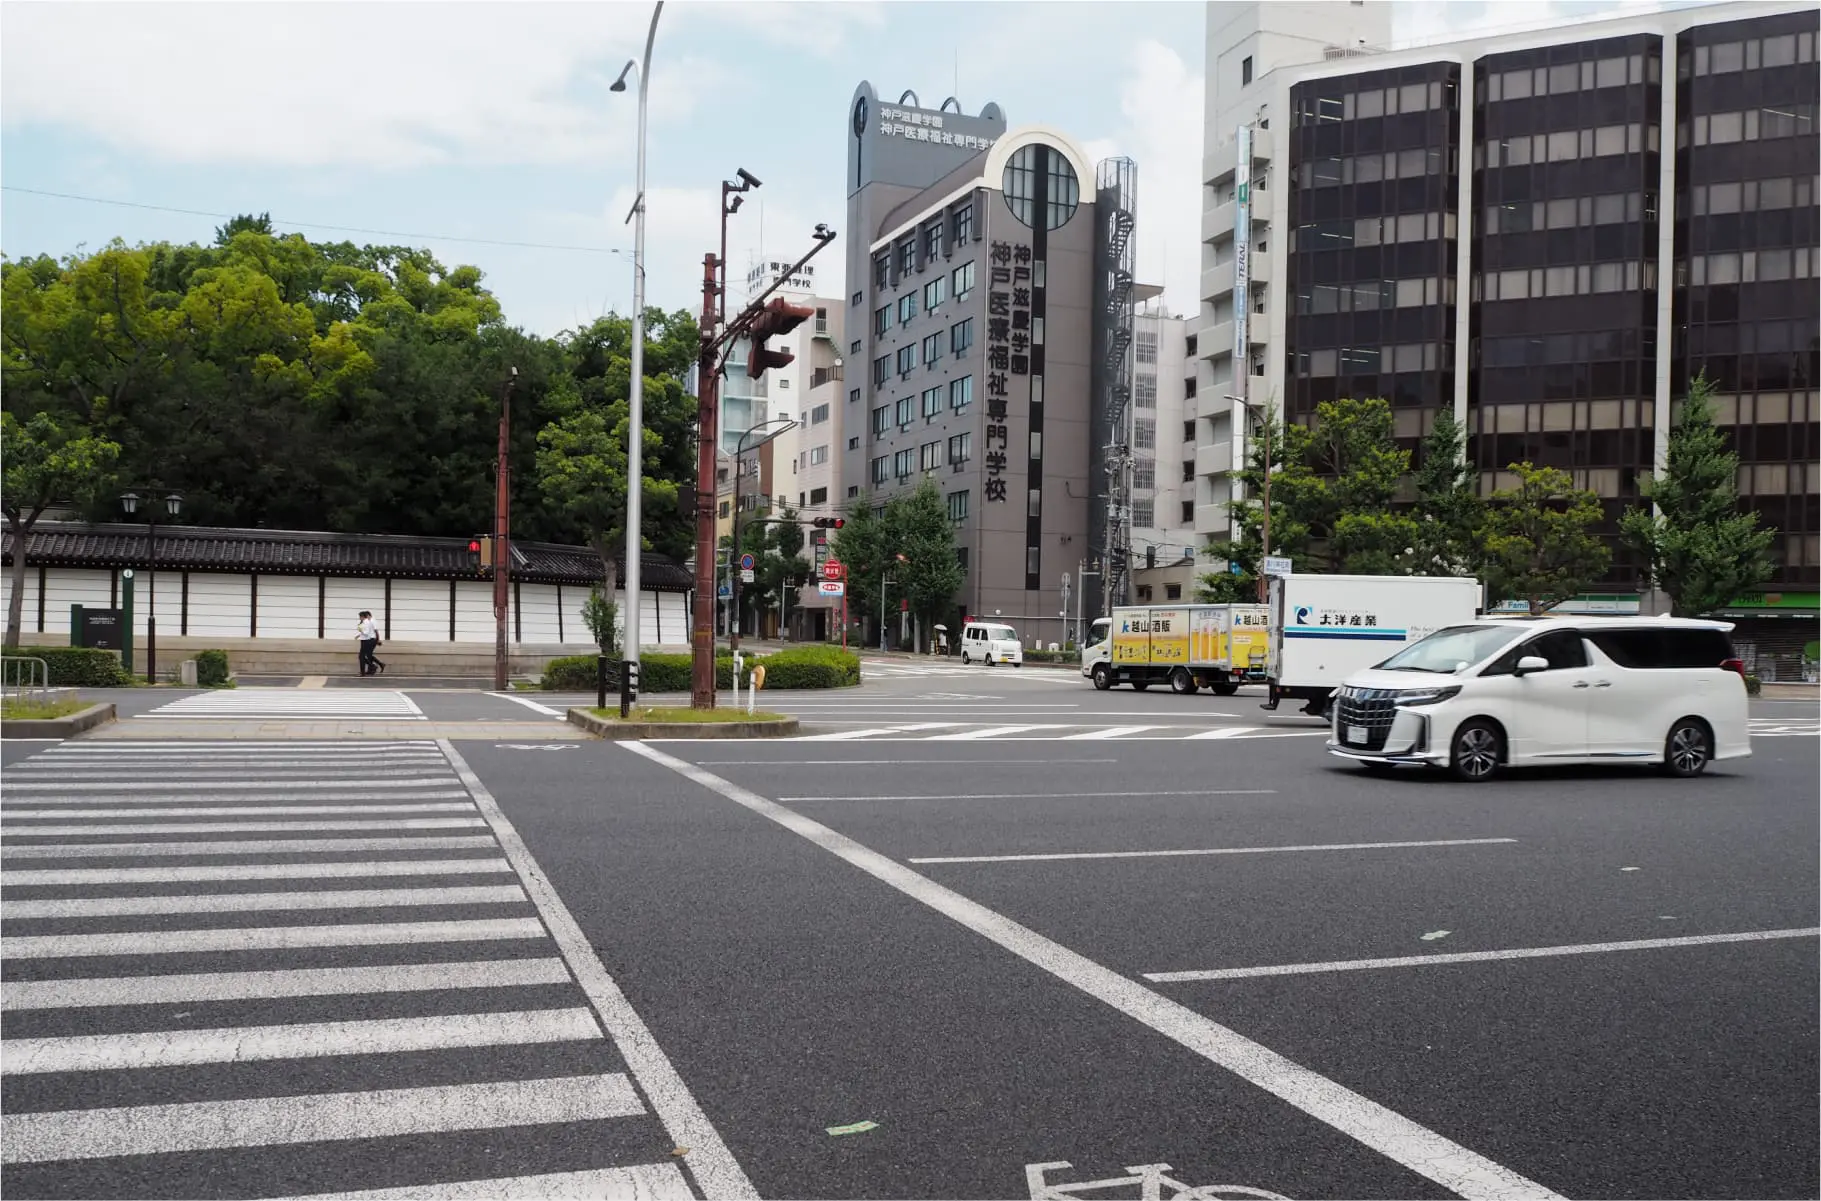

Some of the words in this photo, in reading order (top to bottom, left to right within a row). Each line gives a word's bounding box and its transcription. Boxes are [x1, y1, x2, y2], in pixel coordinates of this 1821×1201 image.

[880, 121, 997, 151] 神戸医療福祉専門学
[1011, 243, 1031, 375] 神戸滋慶学園
[984, 240, 1011, 502] 神戸医療福祉専門学校
[1508, 601, 1529, 609] Famil
[1131, 620, 1171, 632] 越山酒販
[1244, 615, 1268, 625] 越山酒
